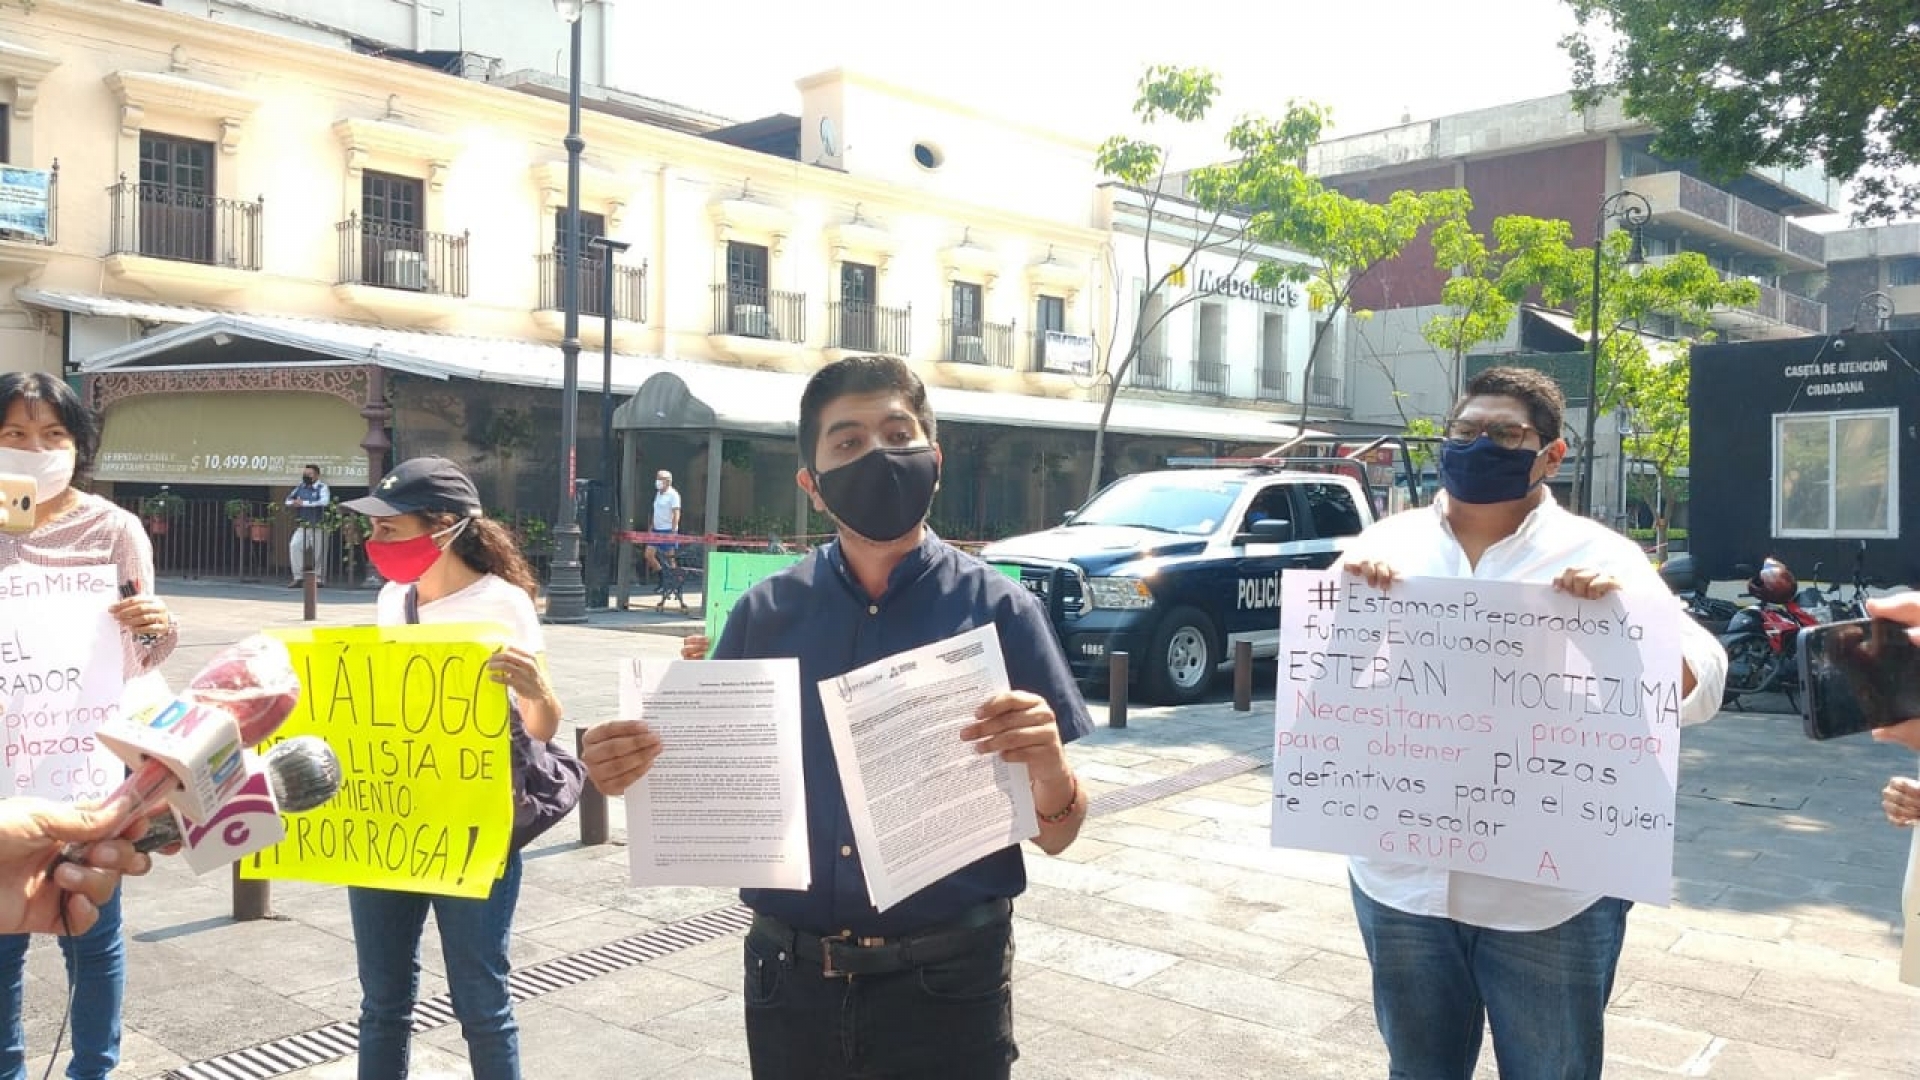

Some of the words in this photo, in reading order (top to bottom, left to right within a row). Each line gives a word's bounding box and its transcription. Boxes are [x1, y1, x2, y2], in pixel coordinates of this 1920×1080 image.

[1784, 363, 1821, 377] CASETA
[1822, 362, 1837, 375] DE
[1838, 356, 1888, 373] ATENCIÓN
[1806, 380, 1864, 396] CIUDADANA
[203, 454, 269, 471] 10,499.00
[1, 628, 32, 663] EL
[305, 644, 511, 739] IÁLOGO
[1289, 650, 1448, 697] ESTEBAN
[1492, 665, 1680, 729] MOCTEZUMA
[1277, 730, 1341, 757] para
[1367, 731, 1471, 763] obtener
[1295, 689, 1494, 734] Necesitamos
[1532, 716, 1662, 765] prórroga
[5, 734, 96, 768] plazas
[347, 737, 441, 780] LISTA
[459, 748, 495, 781] DE
[16, 757, 36, 788] el
[50, 756, 108, 787] ciclo
[1287, 755, 1427, 794] definitivas
[1454, 785, 1517, 812] para
[1541, 784, 1564, 817] el
[1275, 788, 1300, 813] te
[1322, 793, 1380, 821] ciclo
[1398, 806, 1506, 838] escolar
[1379, 829, 1488, 864] GRUPO
[1535, 851, 1561, 881] A
